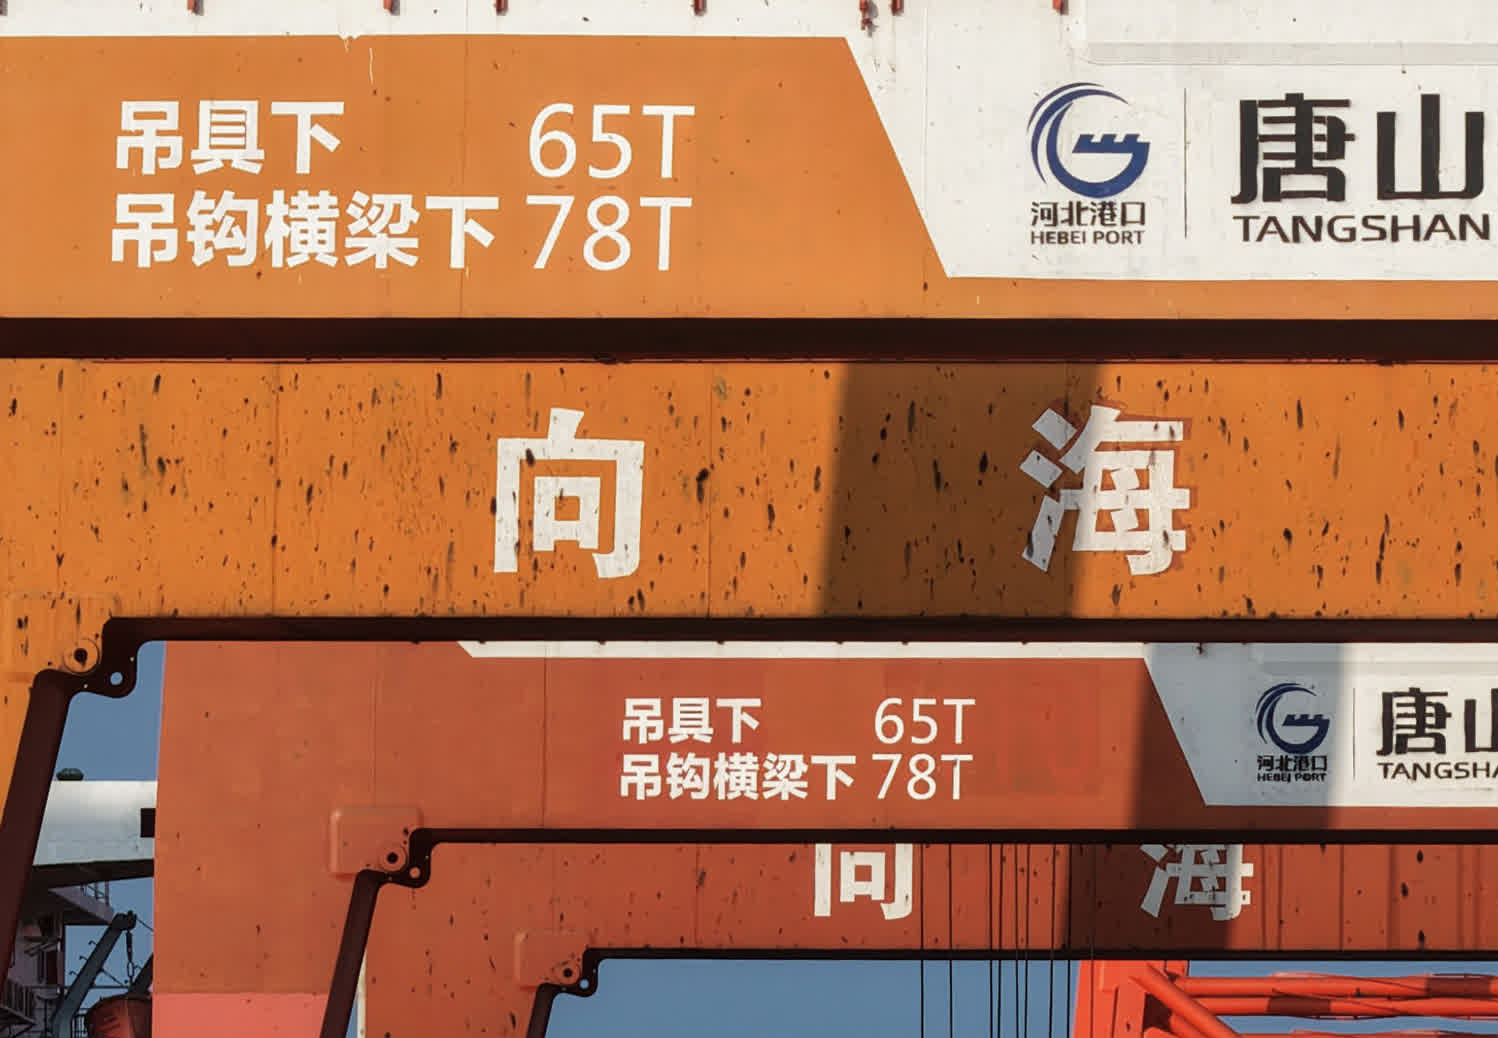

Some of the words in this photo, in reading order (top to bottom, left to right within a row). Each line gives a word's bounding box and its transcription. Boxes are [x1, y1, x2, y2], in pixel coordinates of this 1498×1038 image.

[117, 101, 344, 174] 吊具下
[530, 103, 695, 178] 65T
[112, 190, 498, 268] 吊钩横梁下
[526, 195, 692, 270] 78T
[1031, 201, 1145, 227] 河北港口
[1233, 214, 1490, 243] TANGSHAN
[1031, 231, 1086, 244] HEBEI
[1093, 231, 1144, 244] PORT
[623, 698, 761, 744] 吊具下
[875, 698, 975, 744] 65T
[621, 752, 856, 800] 吊钩横梁下
[872, 754, 973, 800] 78T
[1294, 773, 1326, 782] PORT
